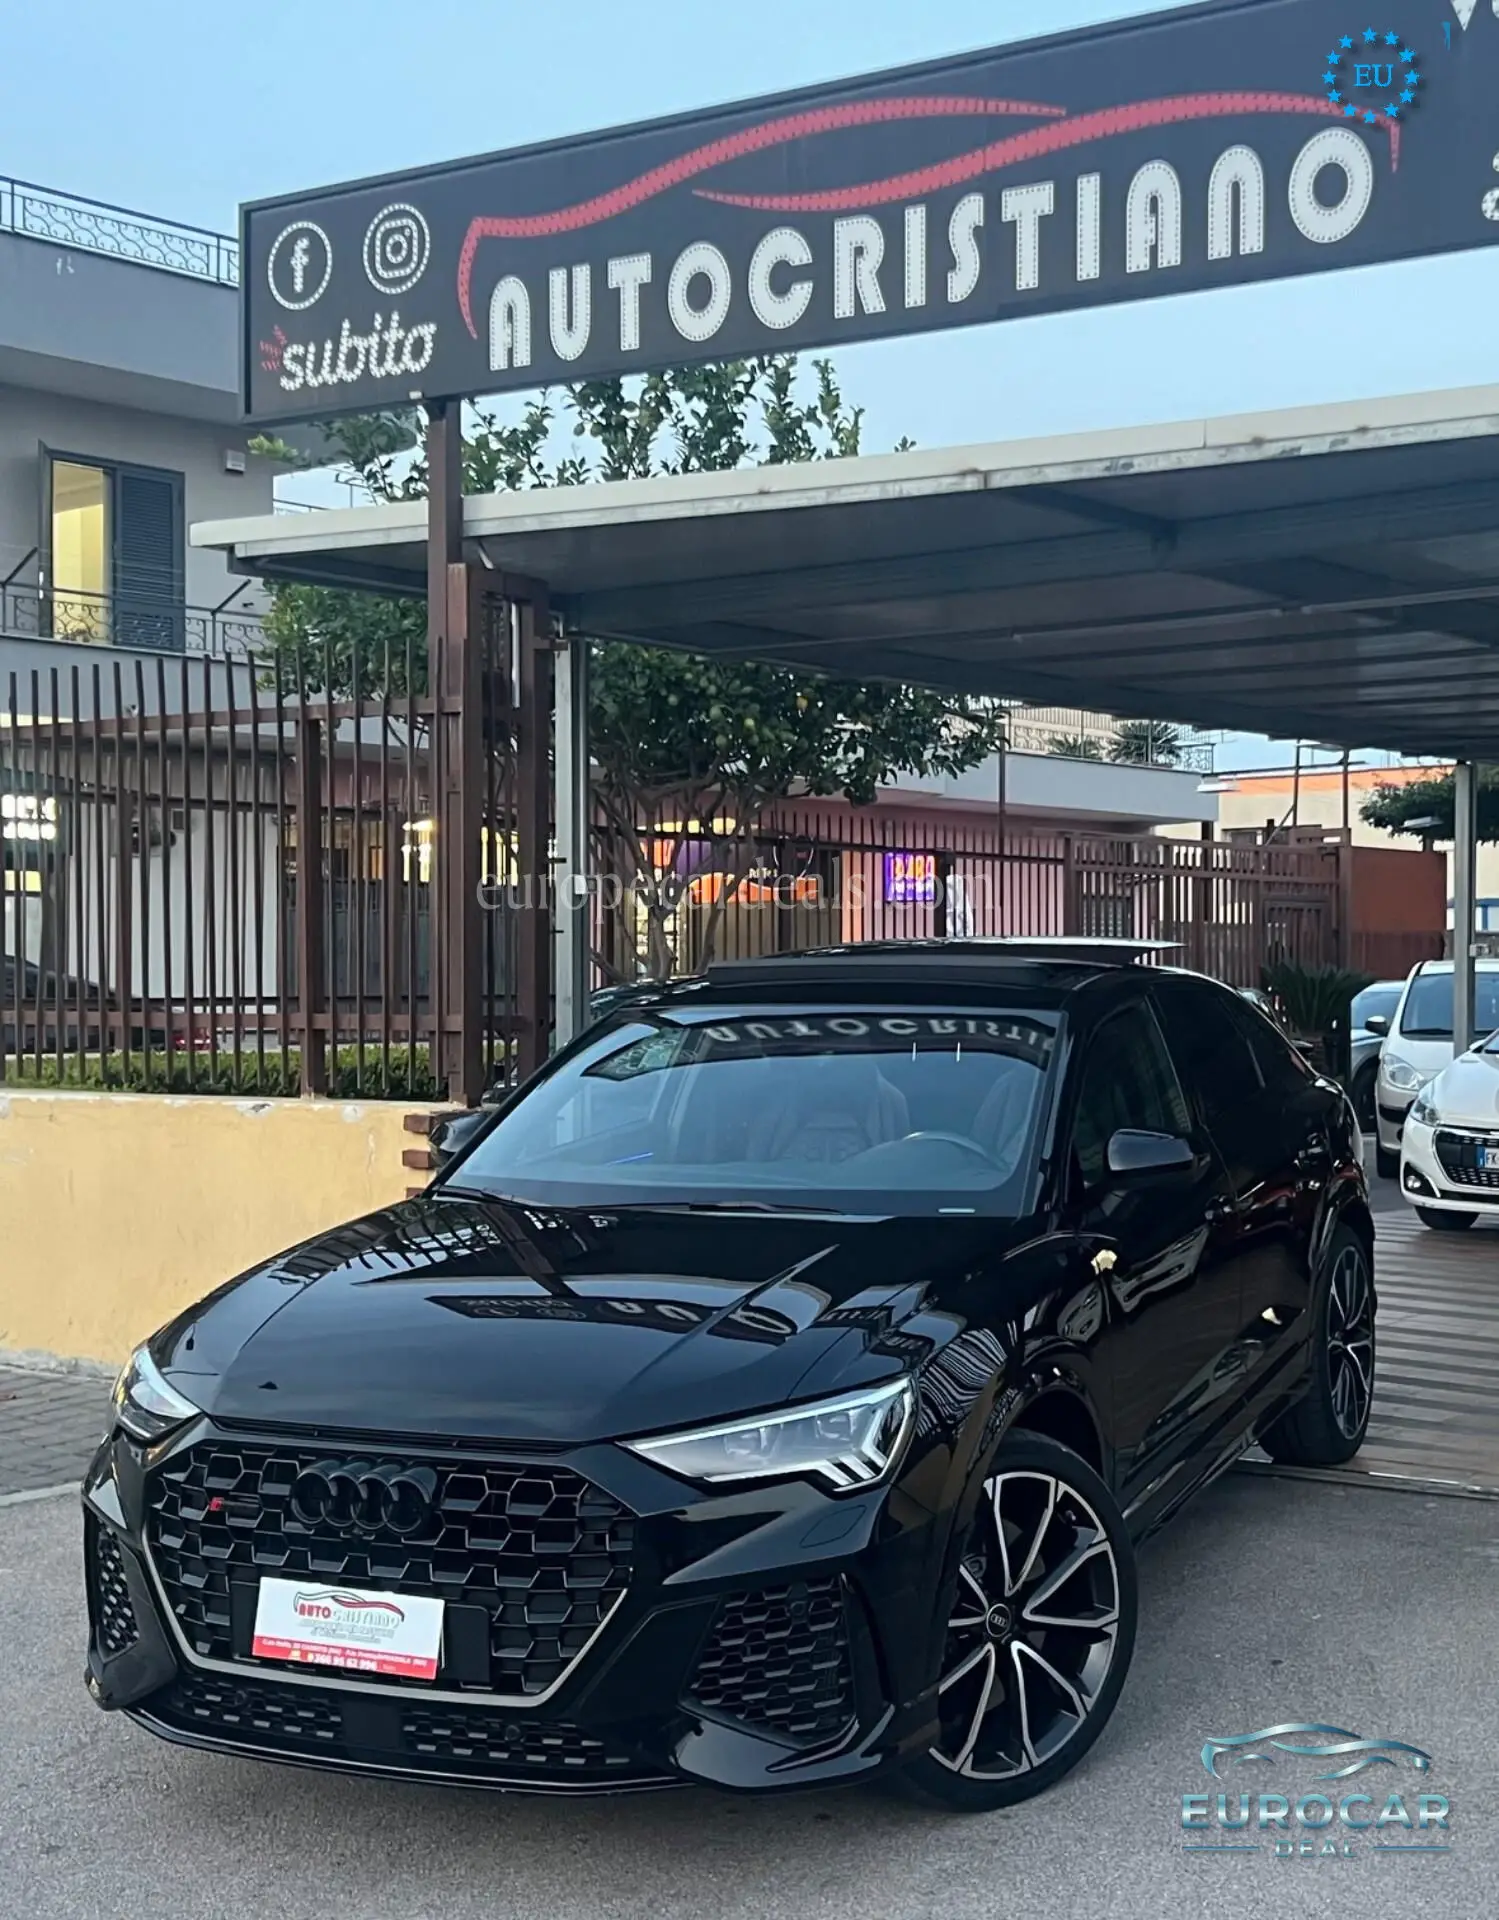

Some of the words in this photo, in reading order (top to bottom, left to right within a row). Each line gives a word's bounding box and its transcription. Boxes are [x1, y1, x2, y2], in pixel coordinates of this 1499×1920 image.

[488, 126, 1374, 372] AUTOCRISTIANO
[279, 311, 438, 391] subito
[299, 1602, 332, 1619] AUTO
